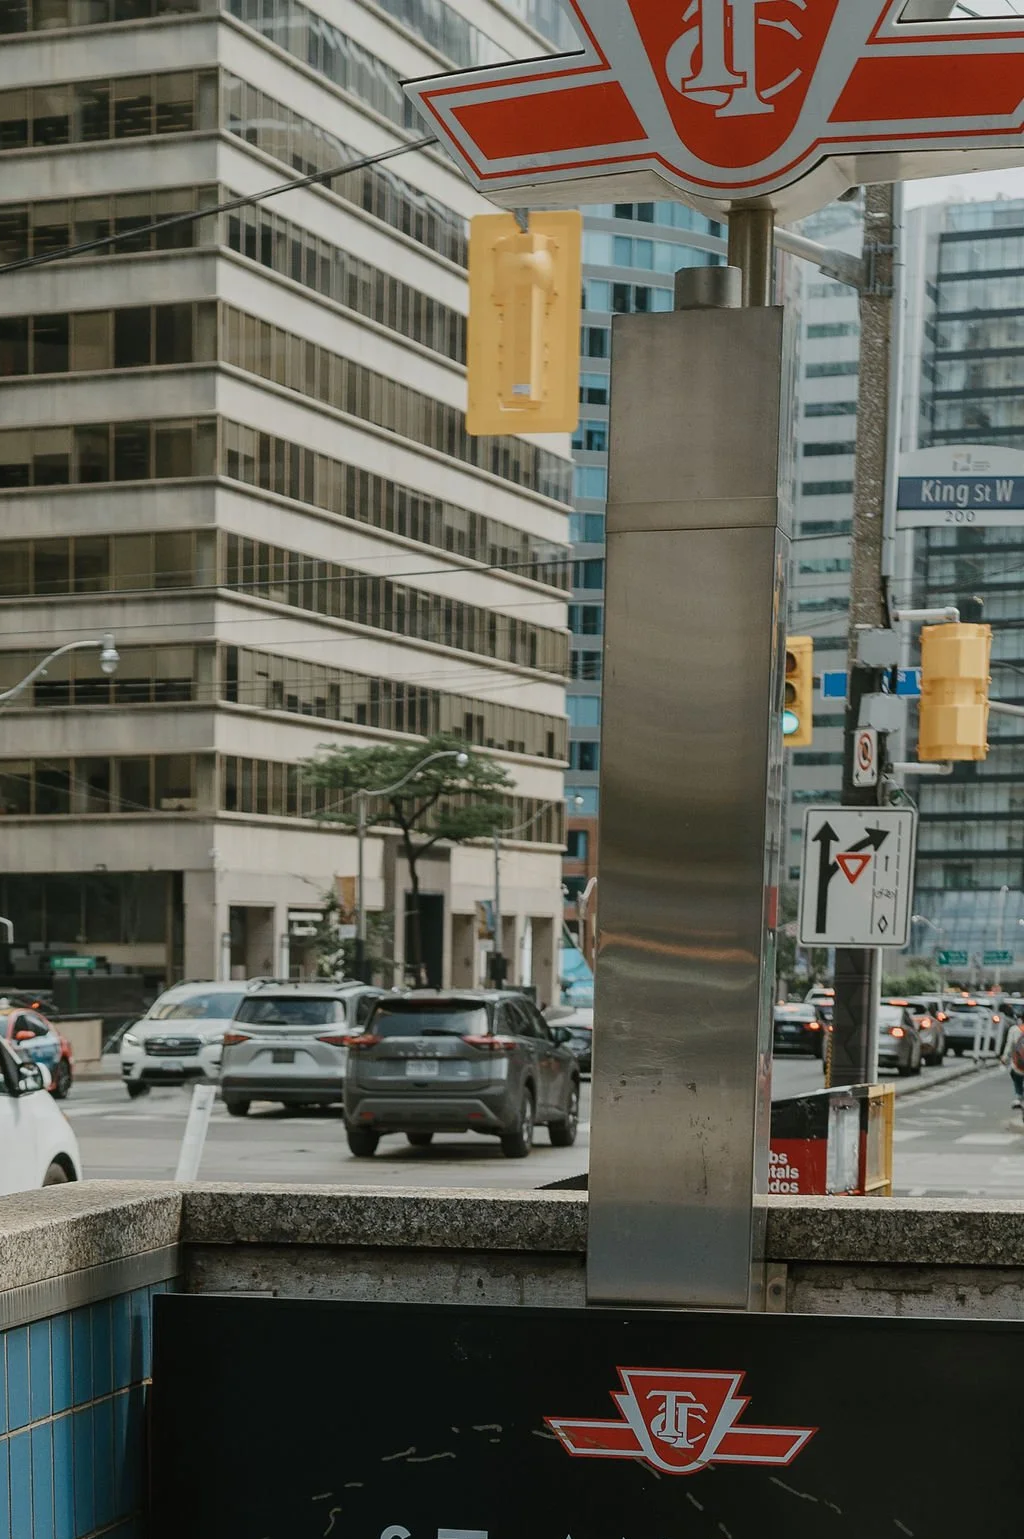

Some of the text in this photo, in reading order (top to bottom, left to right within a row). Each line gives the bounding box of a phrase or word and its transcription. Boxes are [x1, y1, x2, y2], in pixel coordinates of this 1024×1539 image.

[921, 479, 1014, 507] King St W
[945, 510, 976, 522] 200
[769, 1151, 788, 1164] bs
[769, 1165, 800, 1179] tals
[769, 1179, 800, 1193] dos
